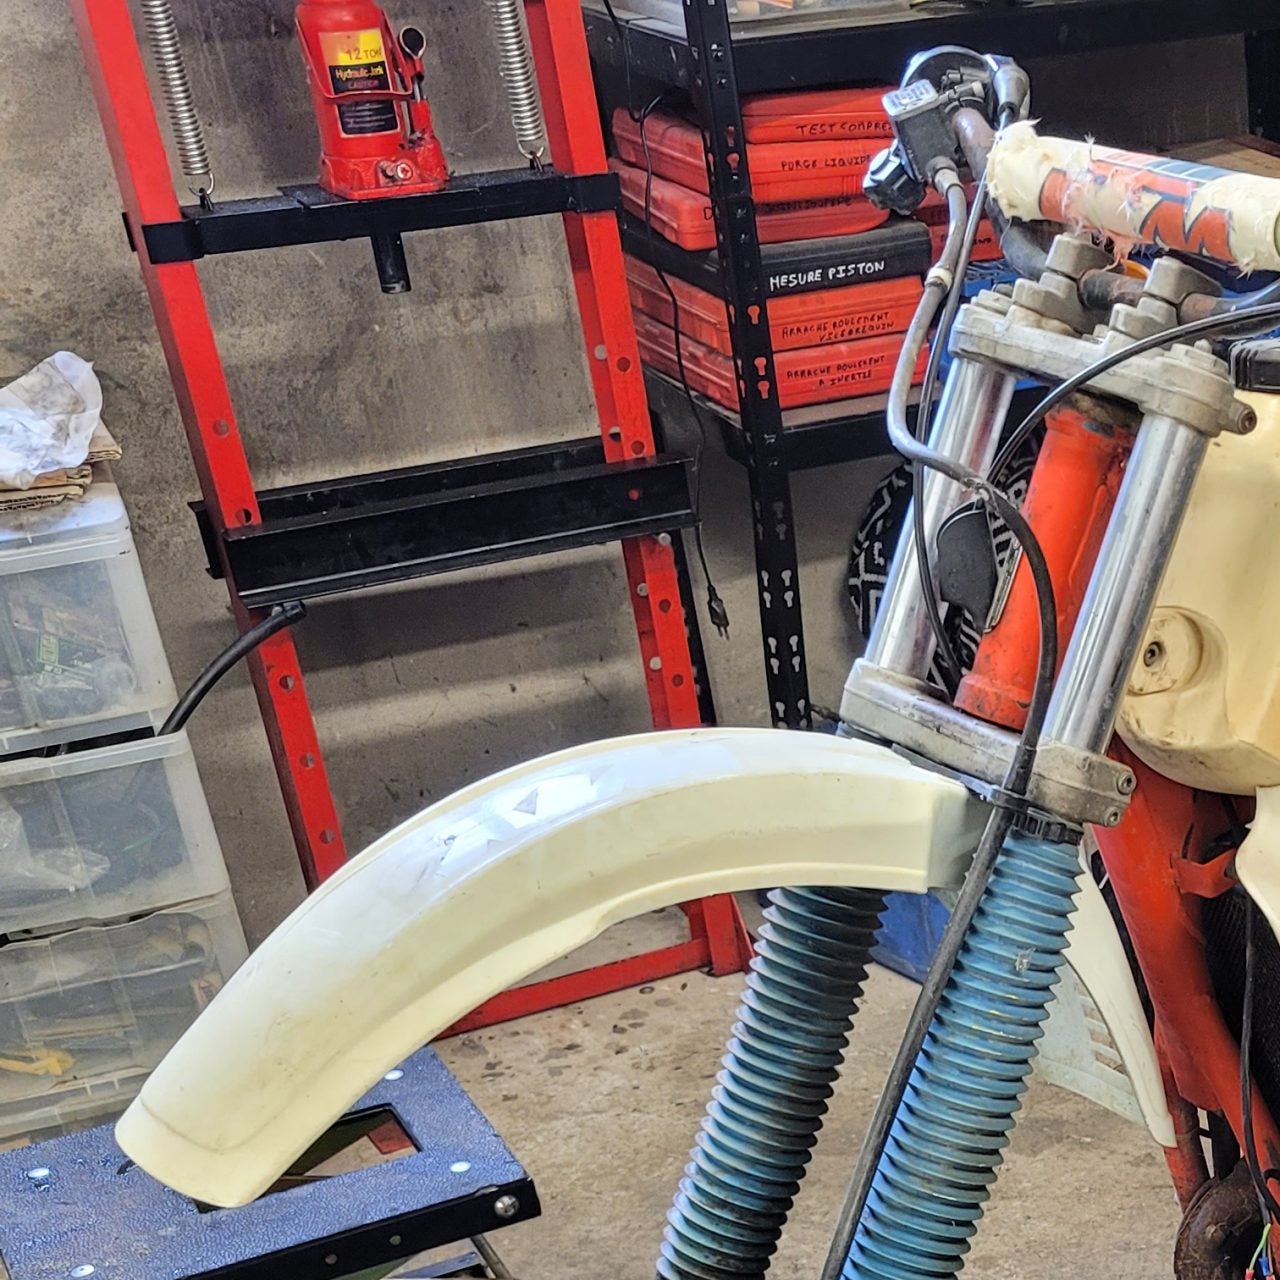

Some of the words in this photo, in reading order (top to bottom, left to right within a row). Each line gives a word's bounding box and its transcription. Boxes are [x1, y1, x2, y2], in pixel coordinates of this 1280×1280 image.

[345, 48, 362, 61] 12
[796, 123, 836, 137] TEST
[781, 160, 817, 171] PURGE
[828, 260, 885, 280] PISTON
[782, 322, 828, 339] ARRACHE
[832, 311, 890, 329] ROULEMENT
[786, 366, 831, 379] ARRACHE
[830, 370, 872, 386] INERTIE
